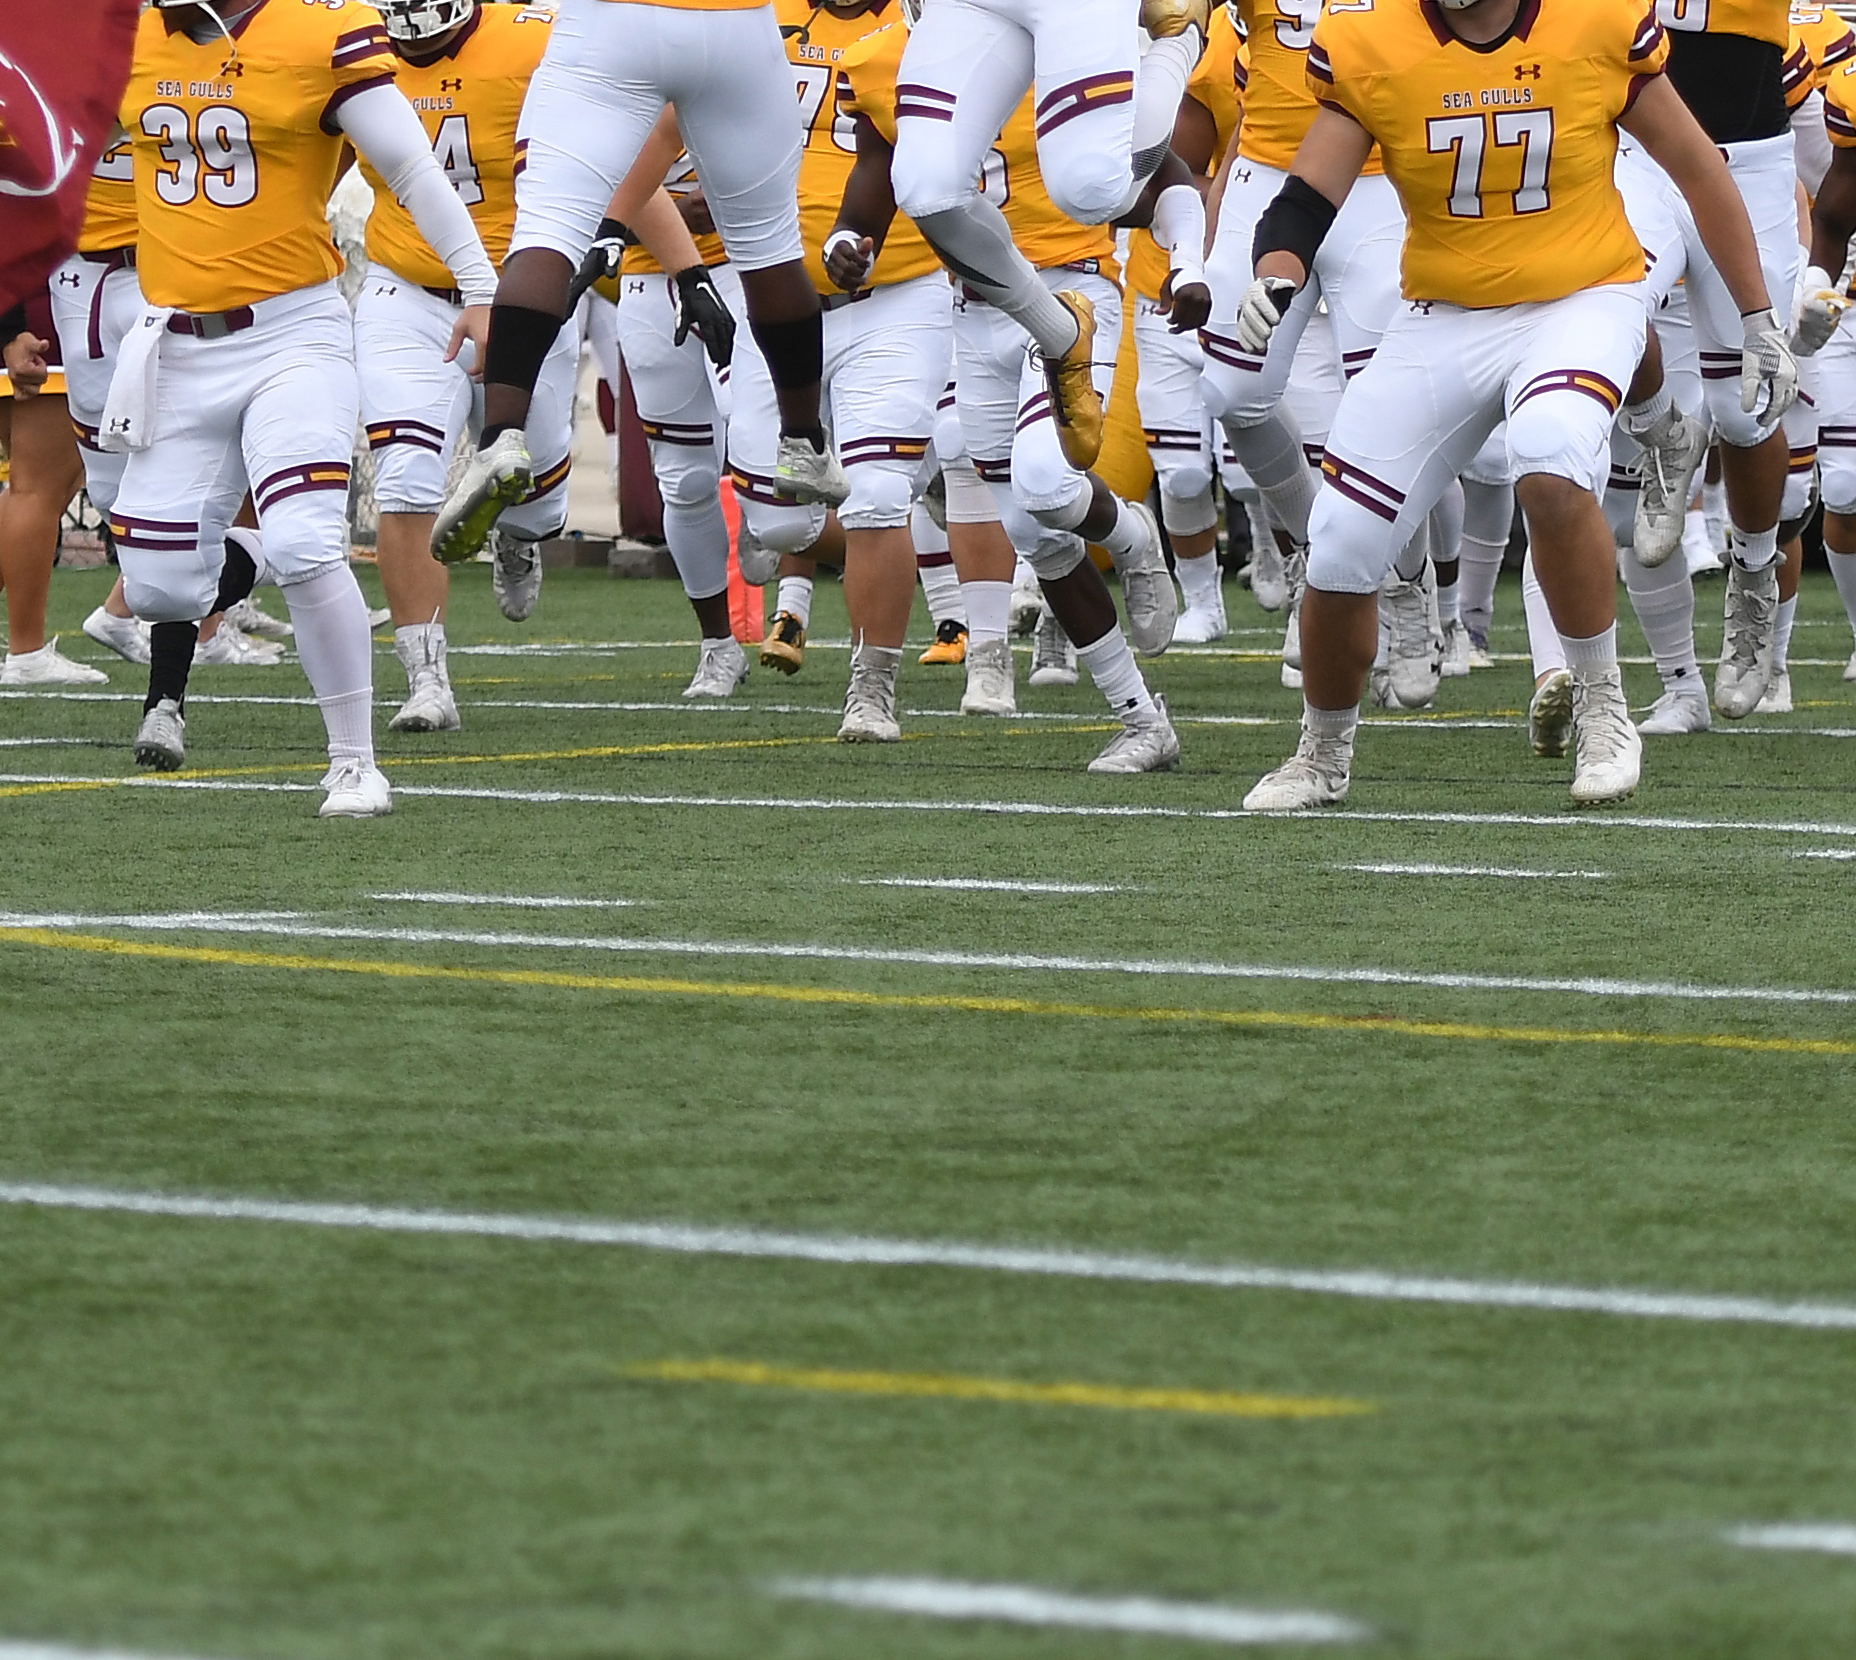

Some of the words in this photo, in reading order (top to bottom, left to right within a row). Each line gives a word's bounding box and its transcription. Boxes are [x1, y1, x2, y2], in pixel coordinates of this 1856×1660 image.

[798, 44, 826, 60] SEA
[157, 81, 183, 97] SEA
[189, 82, 234, 99] GULLS
[1443, 92, 1473, 109] SEA
[1480, 87, 1533, 106] GULLS
[412, 97, 454, 111] GULLS
[140, 102, 259, 208] 39
[1425, 106, 1555, 219] 77
